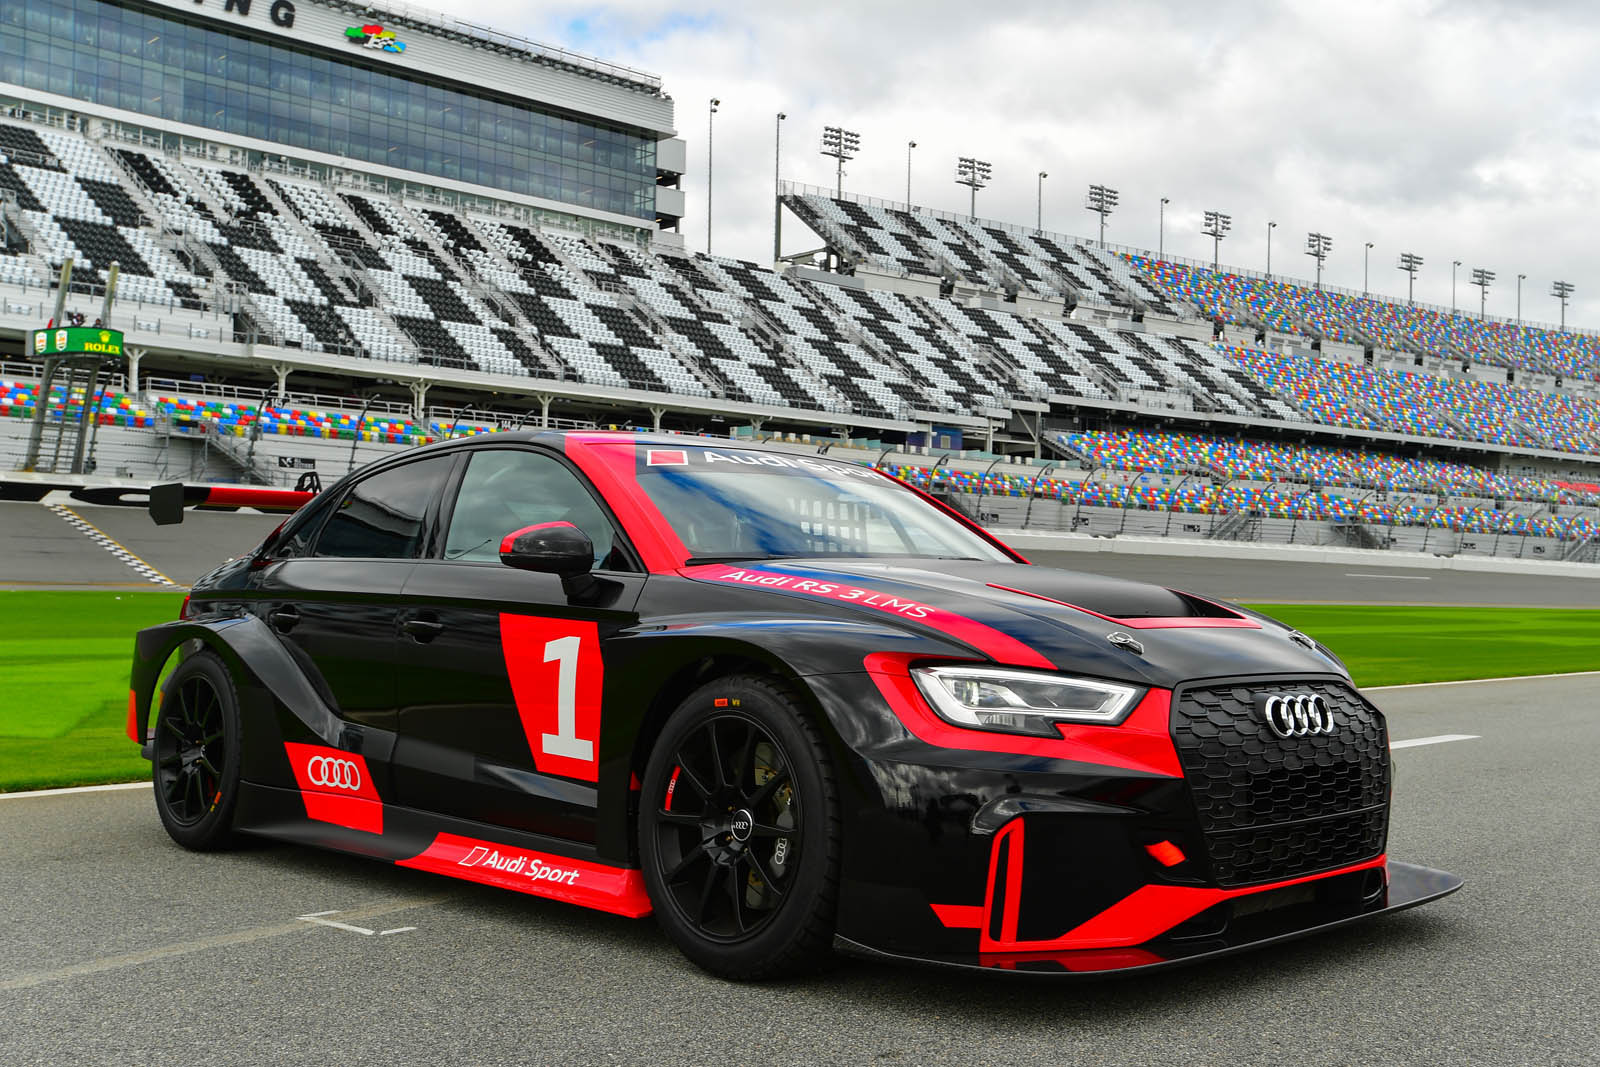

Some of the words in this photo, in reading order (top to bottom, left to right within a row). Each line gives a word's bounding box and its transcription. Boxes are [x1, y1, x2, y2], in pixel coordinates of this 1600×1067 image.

[193, 0, 296, 28] NG
[84, 342, 120, 354] ROLEX
[704, 451, 799, 468] Audi
[720, 571, 794, 586] Audi
[792, 579, 840, 594] RS
[839, 589, 865, 600] 3
[863, 594, 935, 618] LMS
[542, 636, 593, 761] 1
[482, 851, 528, 873] Audi
[524, 859, 580, 885] Sport
